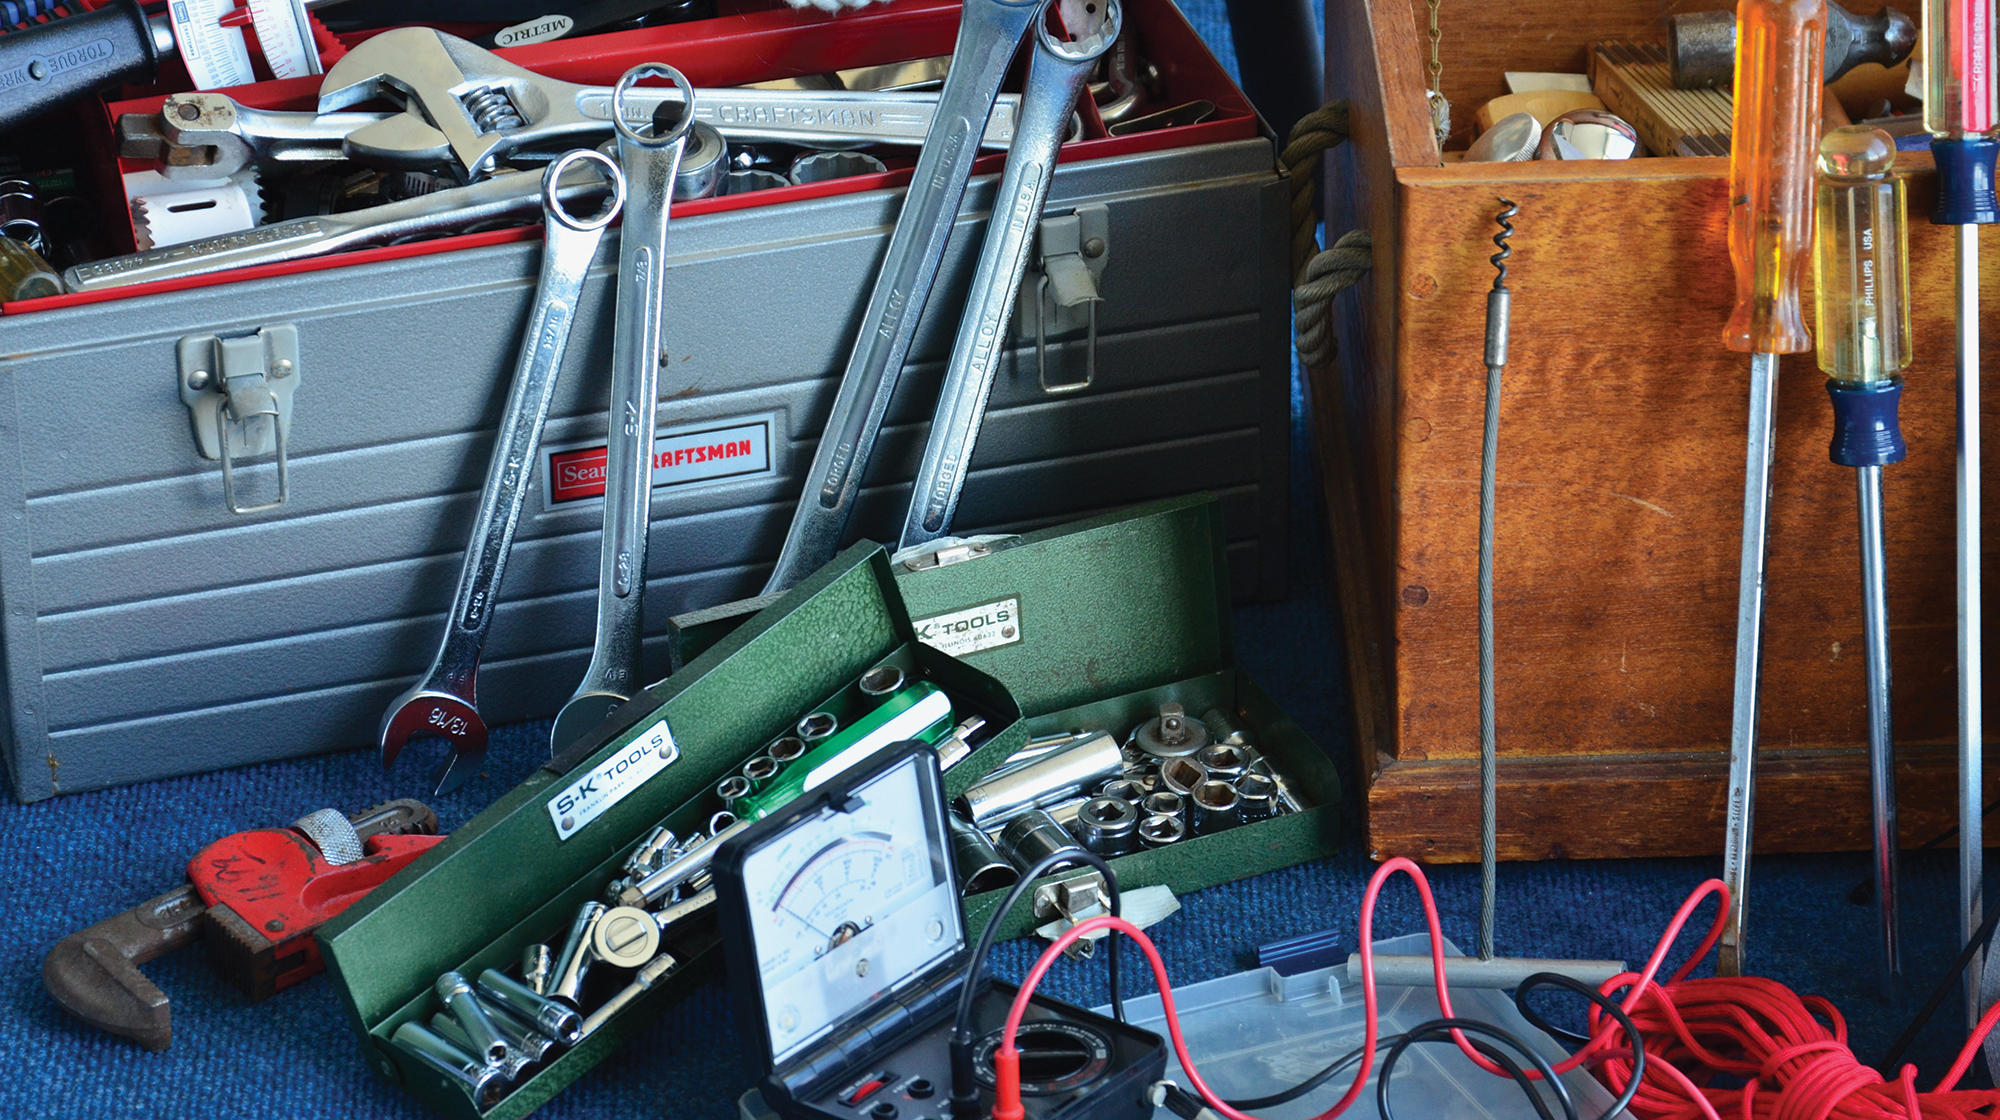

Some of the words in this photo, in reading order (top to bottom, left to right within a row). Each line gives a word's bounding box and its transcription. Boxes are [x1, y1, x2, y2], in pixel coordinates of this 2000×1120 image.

[502, 18, 567, 45] METRIC
[1973, 13, 1984, 80] CRAFTSMAN
[48, 43, 106, 73] TORQUE
[717, 103, 876, 127] CRAFTSMAN
[1863, 228, 1873, 251] USA
[1864, 260, 1874, 306] PHILLIPS
[824, 442, 851, 495] FORGED
[879, 290, 906, 339] ALLOY
[933, 171, 946, 189] IN
[932, 453, 958, 510] FORGED
[972, 316, 998, 372] ALLOY
[1011, 213, 1025, 233] IN
[504, 456, 521, 486] S-K
[565, 466, 607, 483] Sear
[653, 439, 752, 469] RAFTSMAN
[942, 610, 1010, 635] TOOLS
[428, 707, 467, 735] 13/16
[557, 777, 598, 816] S-K
[604, 734, 663, 780] TOOLS
[579, 793, 609, 816] FRANKLIN
